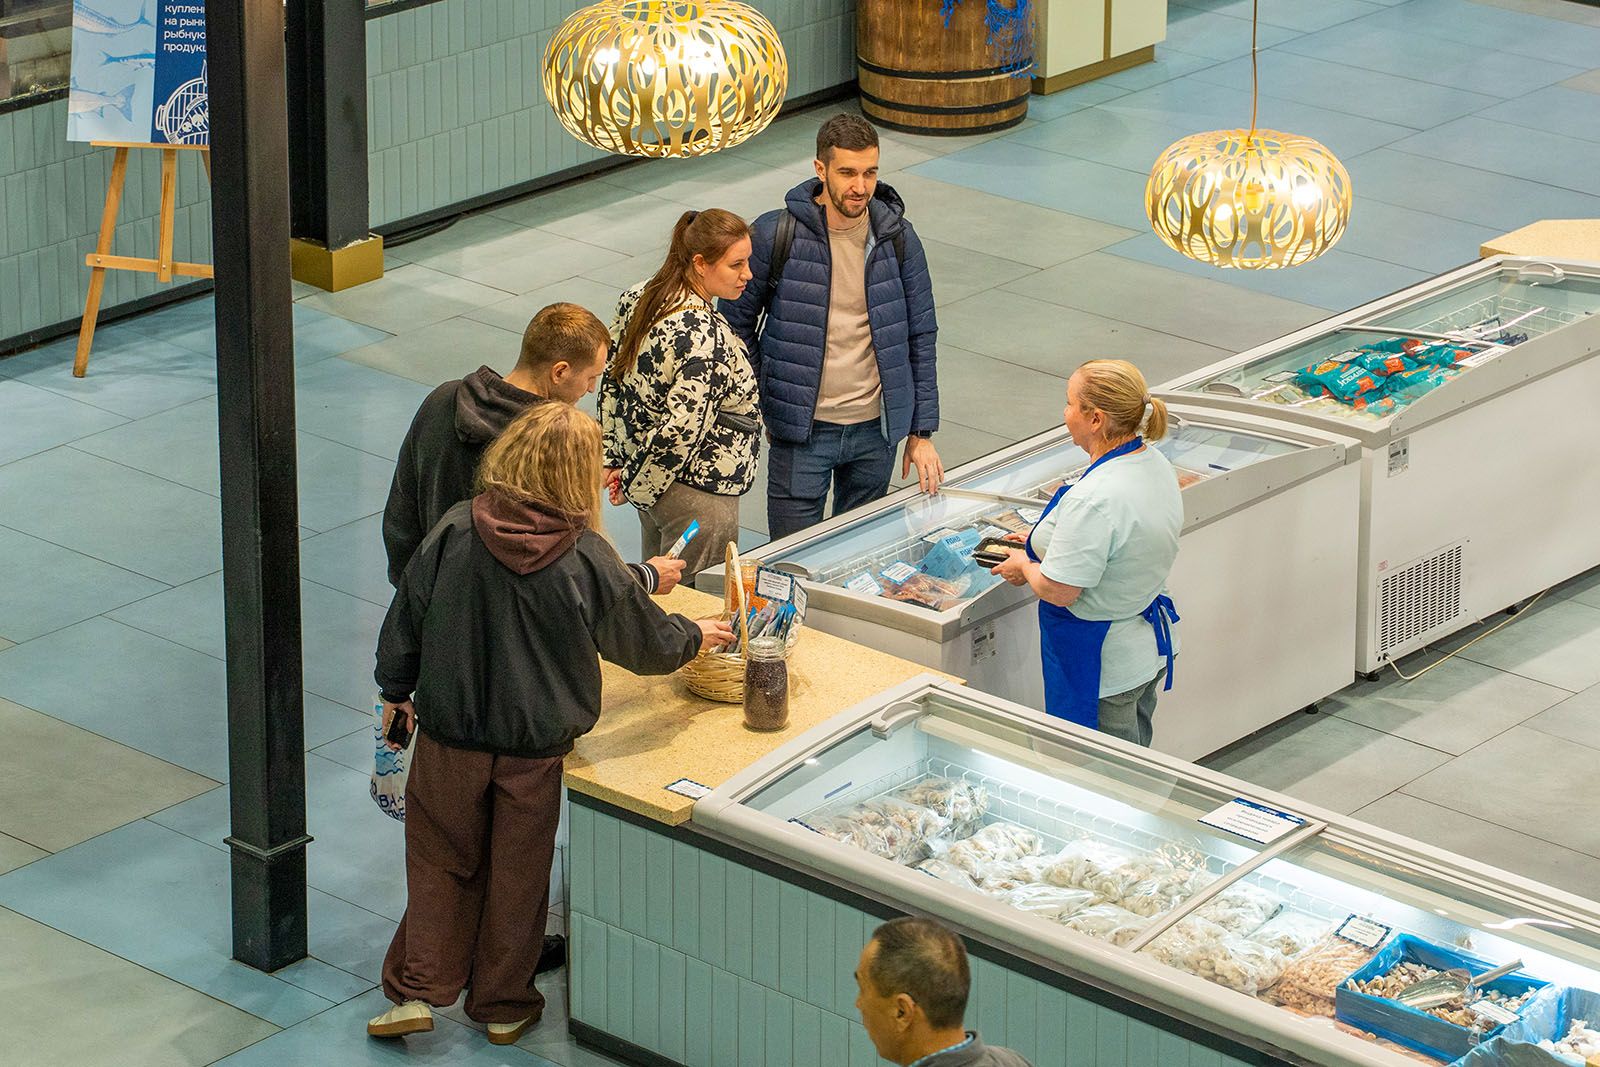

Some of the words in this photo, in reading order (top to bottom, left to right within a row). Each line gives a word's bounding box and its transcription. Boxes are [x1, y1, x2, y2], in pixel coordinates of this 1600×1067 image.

[164, 17, 177, 26] на
[179, 18, 206, 28] рынк
[164, 29, 206, 41] рыбную
